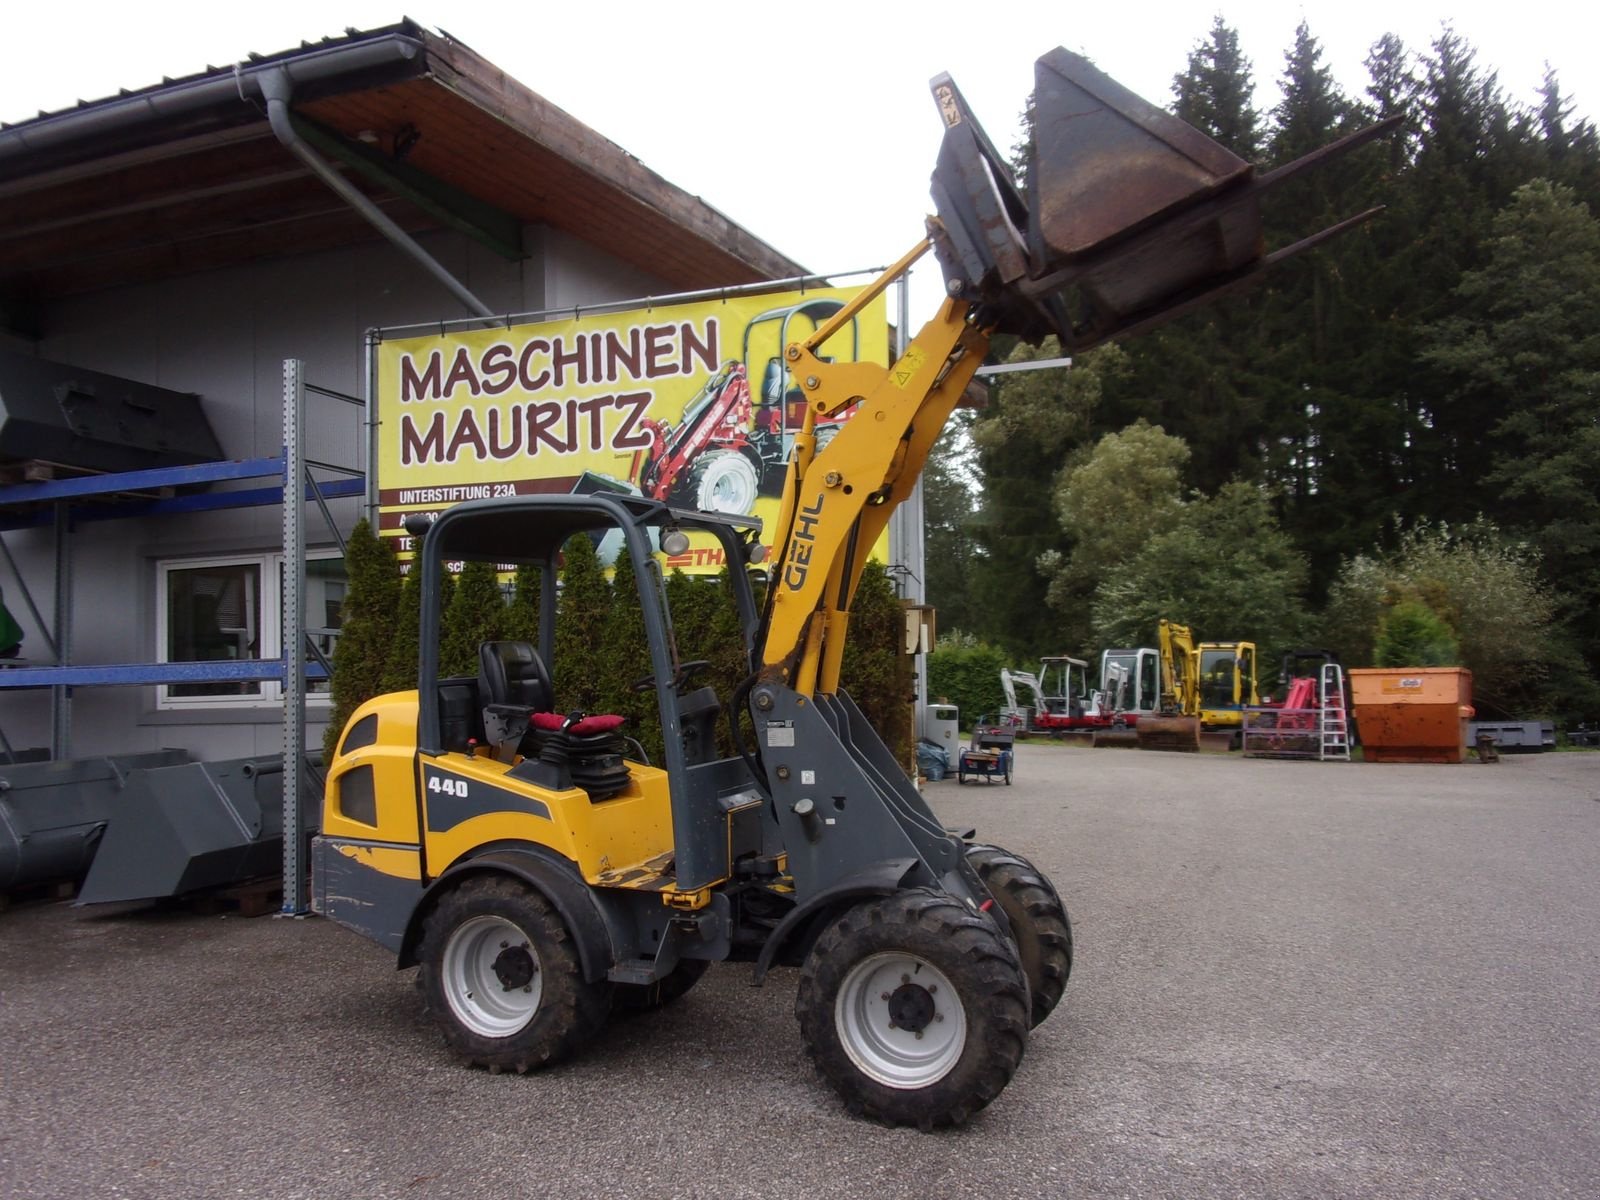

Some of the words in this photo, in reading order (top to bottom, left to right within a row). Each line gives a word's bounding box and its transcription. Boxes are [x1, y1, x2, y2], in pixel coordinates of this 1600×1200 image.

[401, 319, 719, 402] MASCHINEN
[401, 391, 654, 465] MAURITZ
[399, 485, 491, 504] UNTERSTIFTUNG
[493, 483, 517, 498] 23A
[784, 493, 825, 592] GEHL
[428, 776, 468, 798] 440
